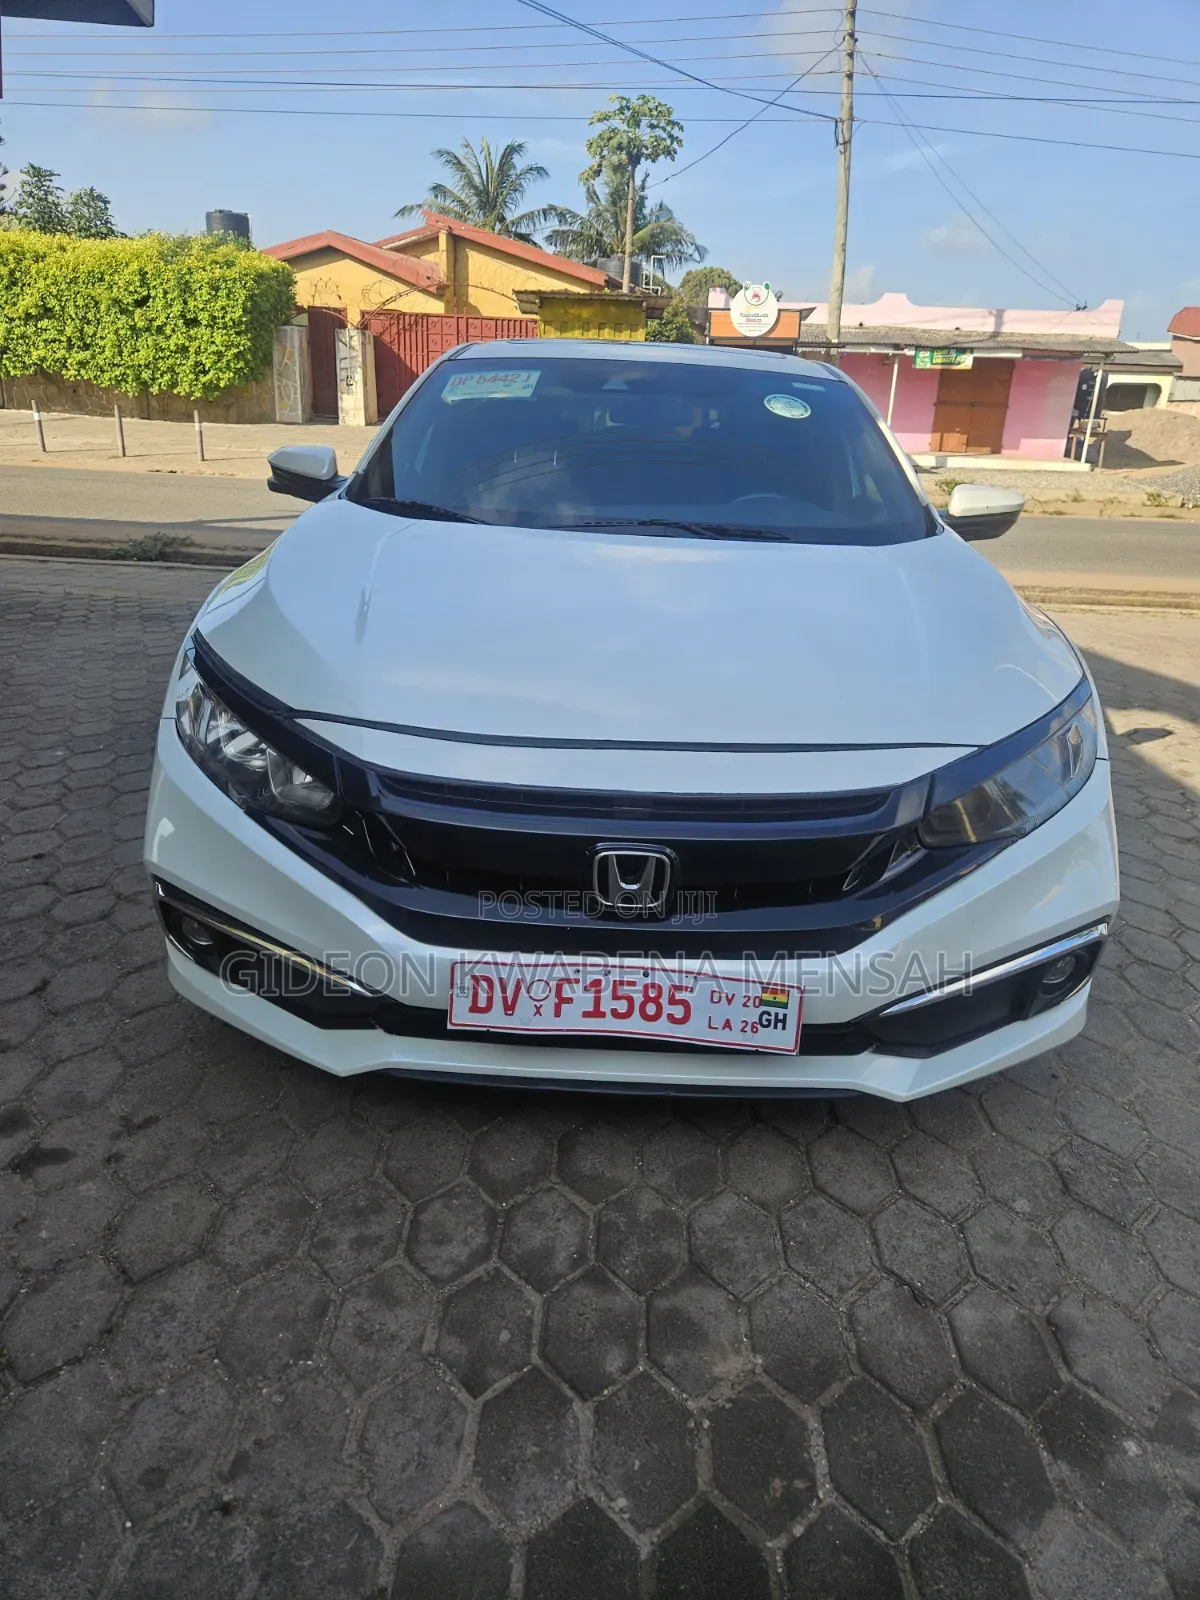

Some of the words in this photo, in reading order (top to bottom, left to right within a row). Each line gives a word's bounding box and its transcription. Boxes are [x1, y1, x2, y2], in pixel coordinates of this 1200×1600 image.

[451, 376, 474, 387] DP
[477, 373, 520, 384] 5442
[469, 974, 524, 1017] DV
[710, 989, 736, 1006] DV
[742, 994, 762, 1009] 20
[708, 1015, 733, 1032] LA
[740, 1019, 760, 1034] 26
[758, 1010, 788, 1031] GH
